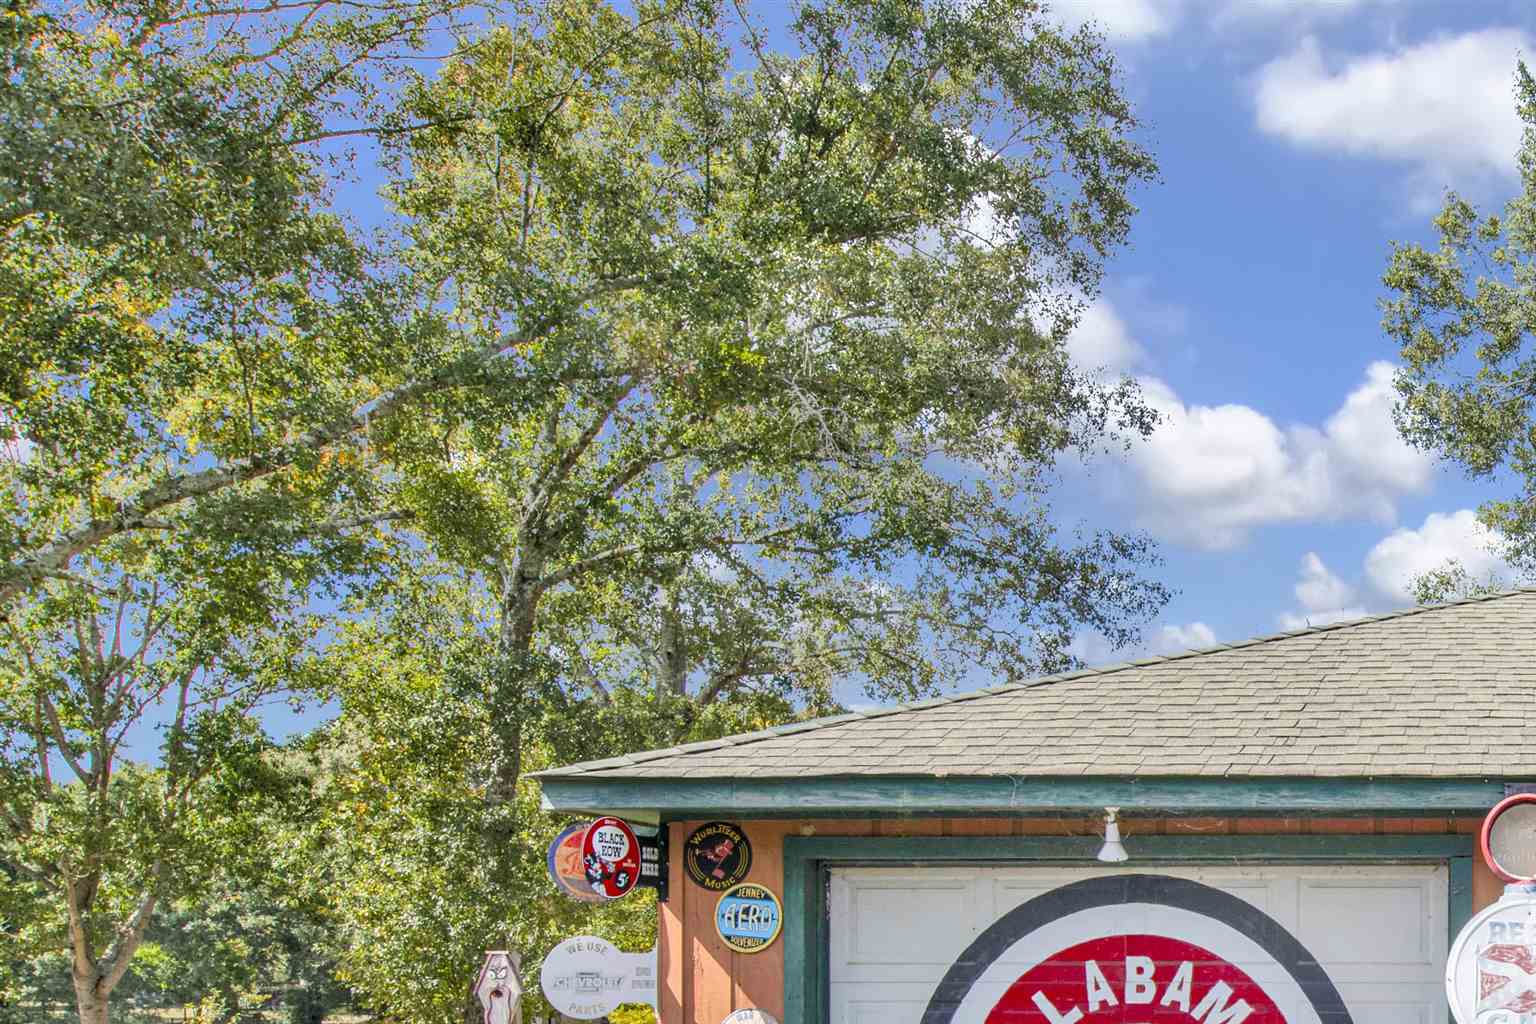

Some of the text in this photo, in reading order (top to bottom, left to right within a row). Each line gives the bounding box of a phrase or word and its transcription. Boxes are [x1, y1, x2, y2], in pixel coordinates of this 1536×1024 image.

[598, 832, 625, 845] BLACK
[736, 887, 765, 899] JENNEY
[724, 903, 772, 932] AERO
[587, 942, 609, 955] USE
